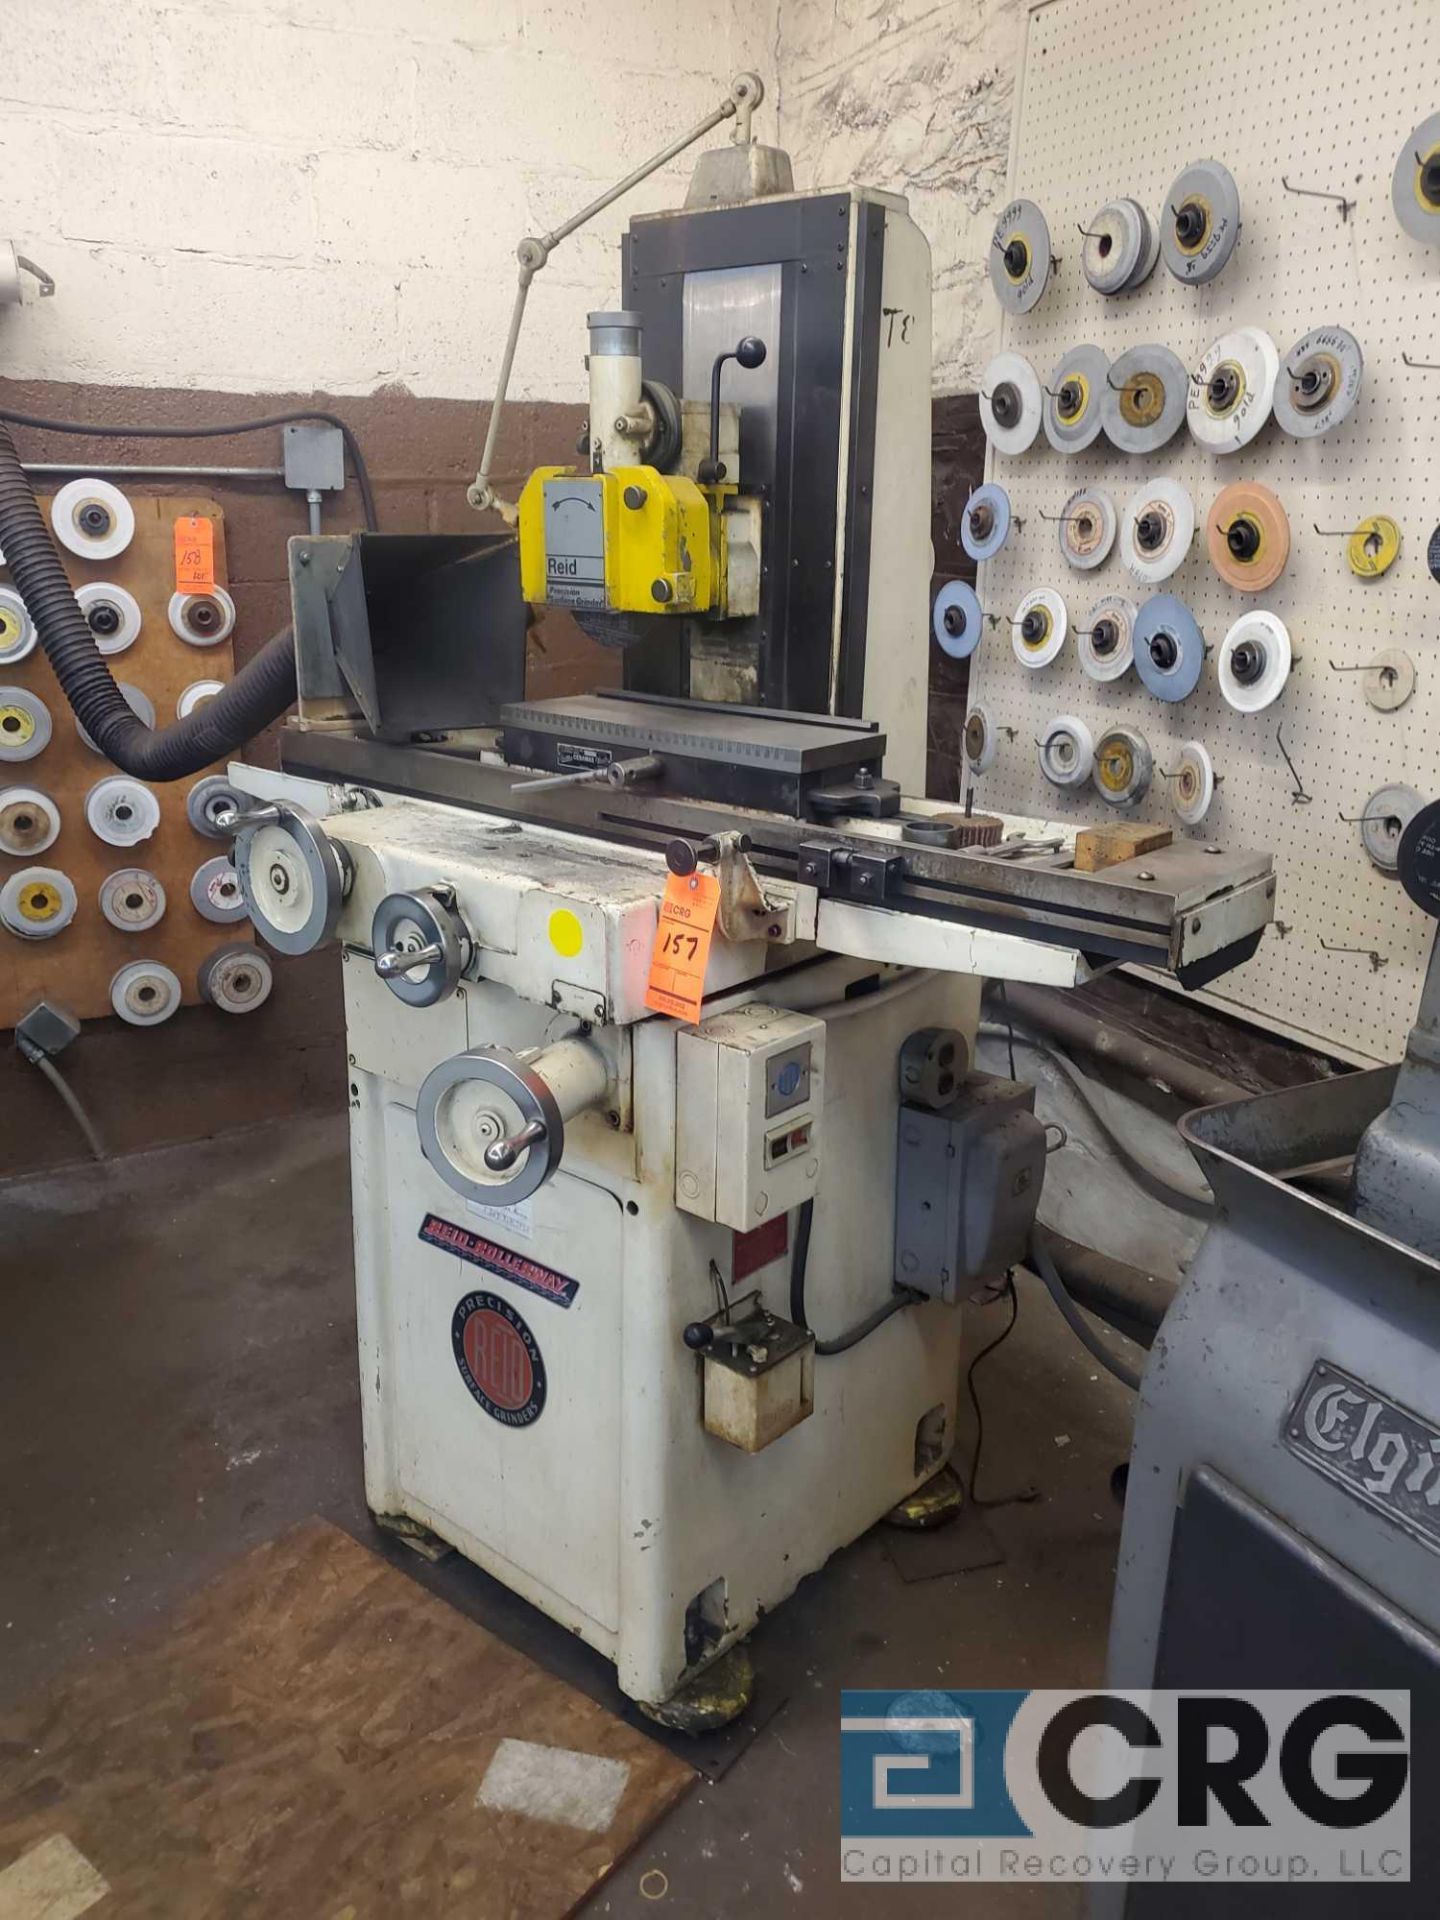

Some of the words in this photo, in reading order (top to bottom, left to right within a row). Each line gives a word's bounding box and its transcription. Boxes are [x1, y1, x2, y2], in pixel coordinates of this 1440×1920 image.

[181, 549, 202, 565] 158
[548, 558, 577, 575] Reid
[672, 904, 692, 919] CRG
[663, 932, 698, 961] 157
[458, 1295, 539, 1362] PRECISION
[474, 1315, 525, 1404] REID
[459, 1357, 492, 1413] SURFACE
[493, 1400, 538, 1424] GRINDERS
[1304, 1384, 1440, 1506] Elgi
